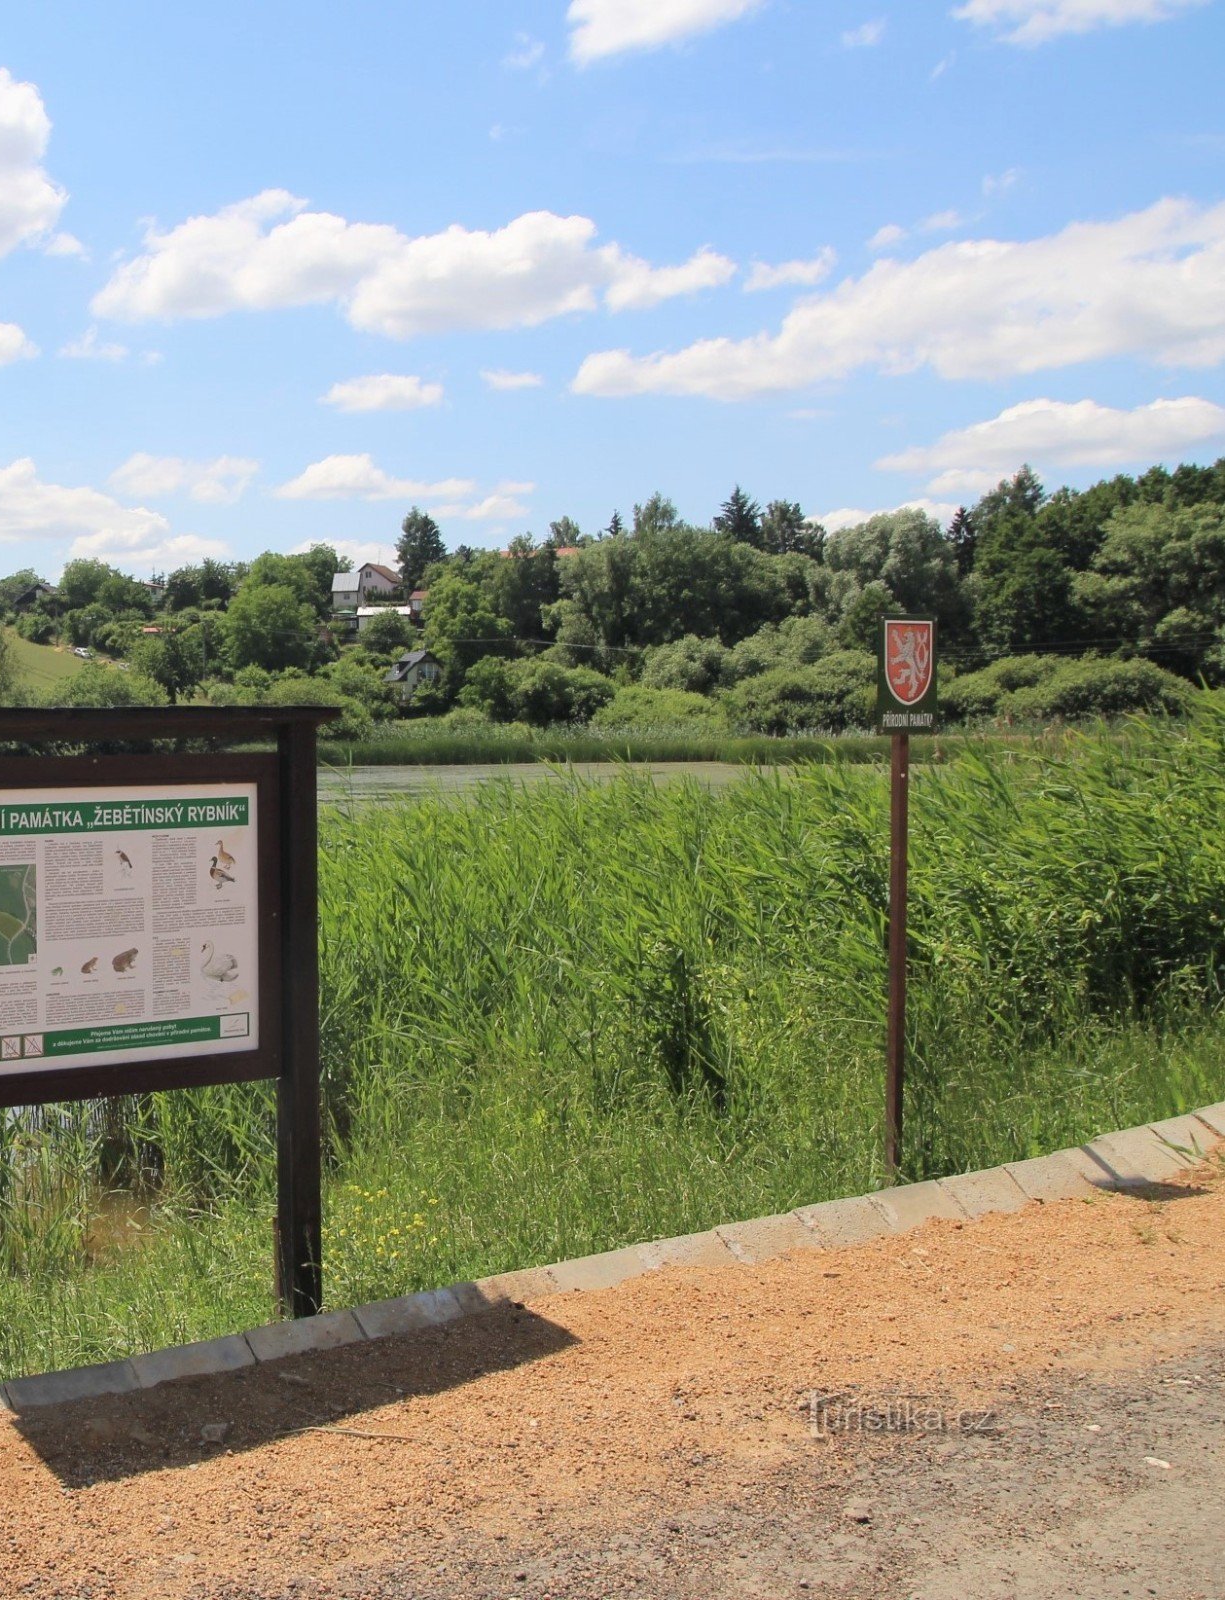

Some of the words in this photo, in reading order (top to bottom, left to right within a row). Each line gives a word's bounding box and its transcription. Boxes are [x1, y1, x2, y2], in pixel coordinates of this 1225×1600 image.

[882, 710, 909, 727] PŘÍRODNÍ
[10, 807, 84, 829] PAMÁTKA
[86, 802, 184, 829] „ŽEBĚTÍNSKÝ
[187, 801, 246, 822] RYBNÍK“
